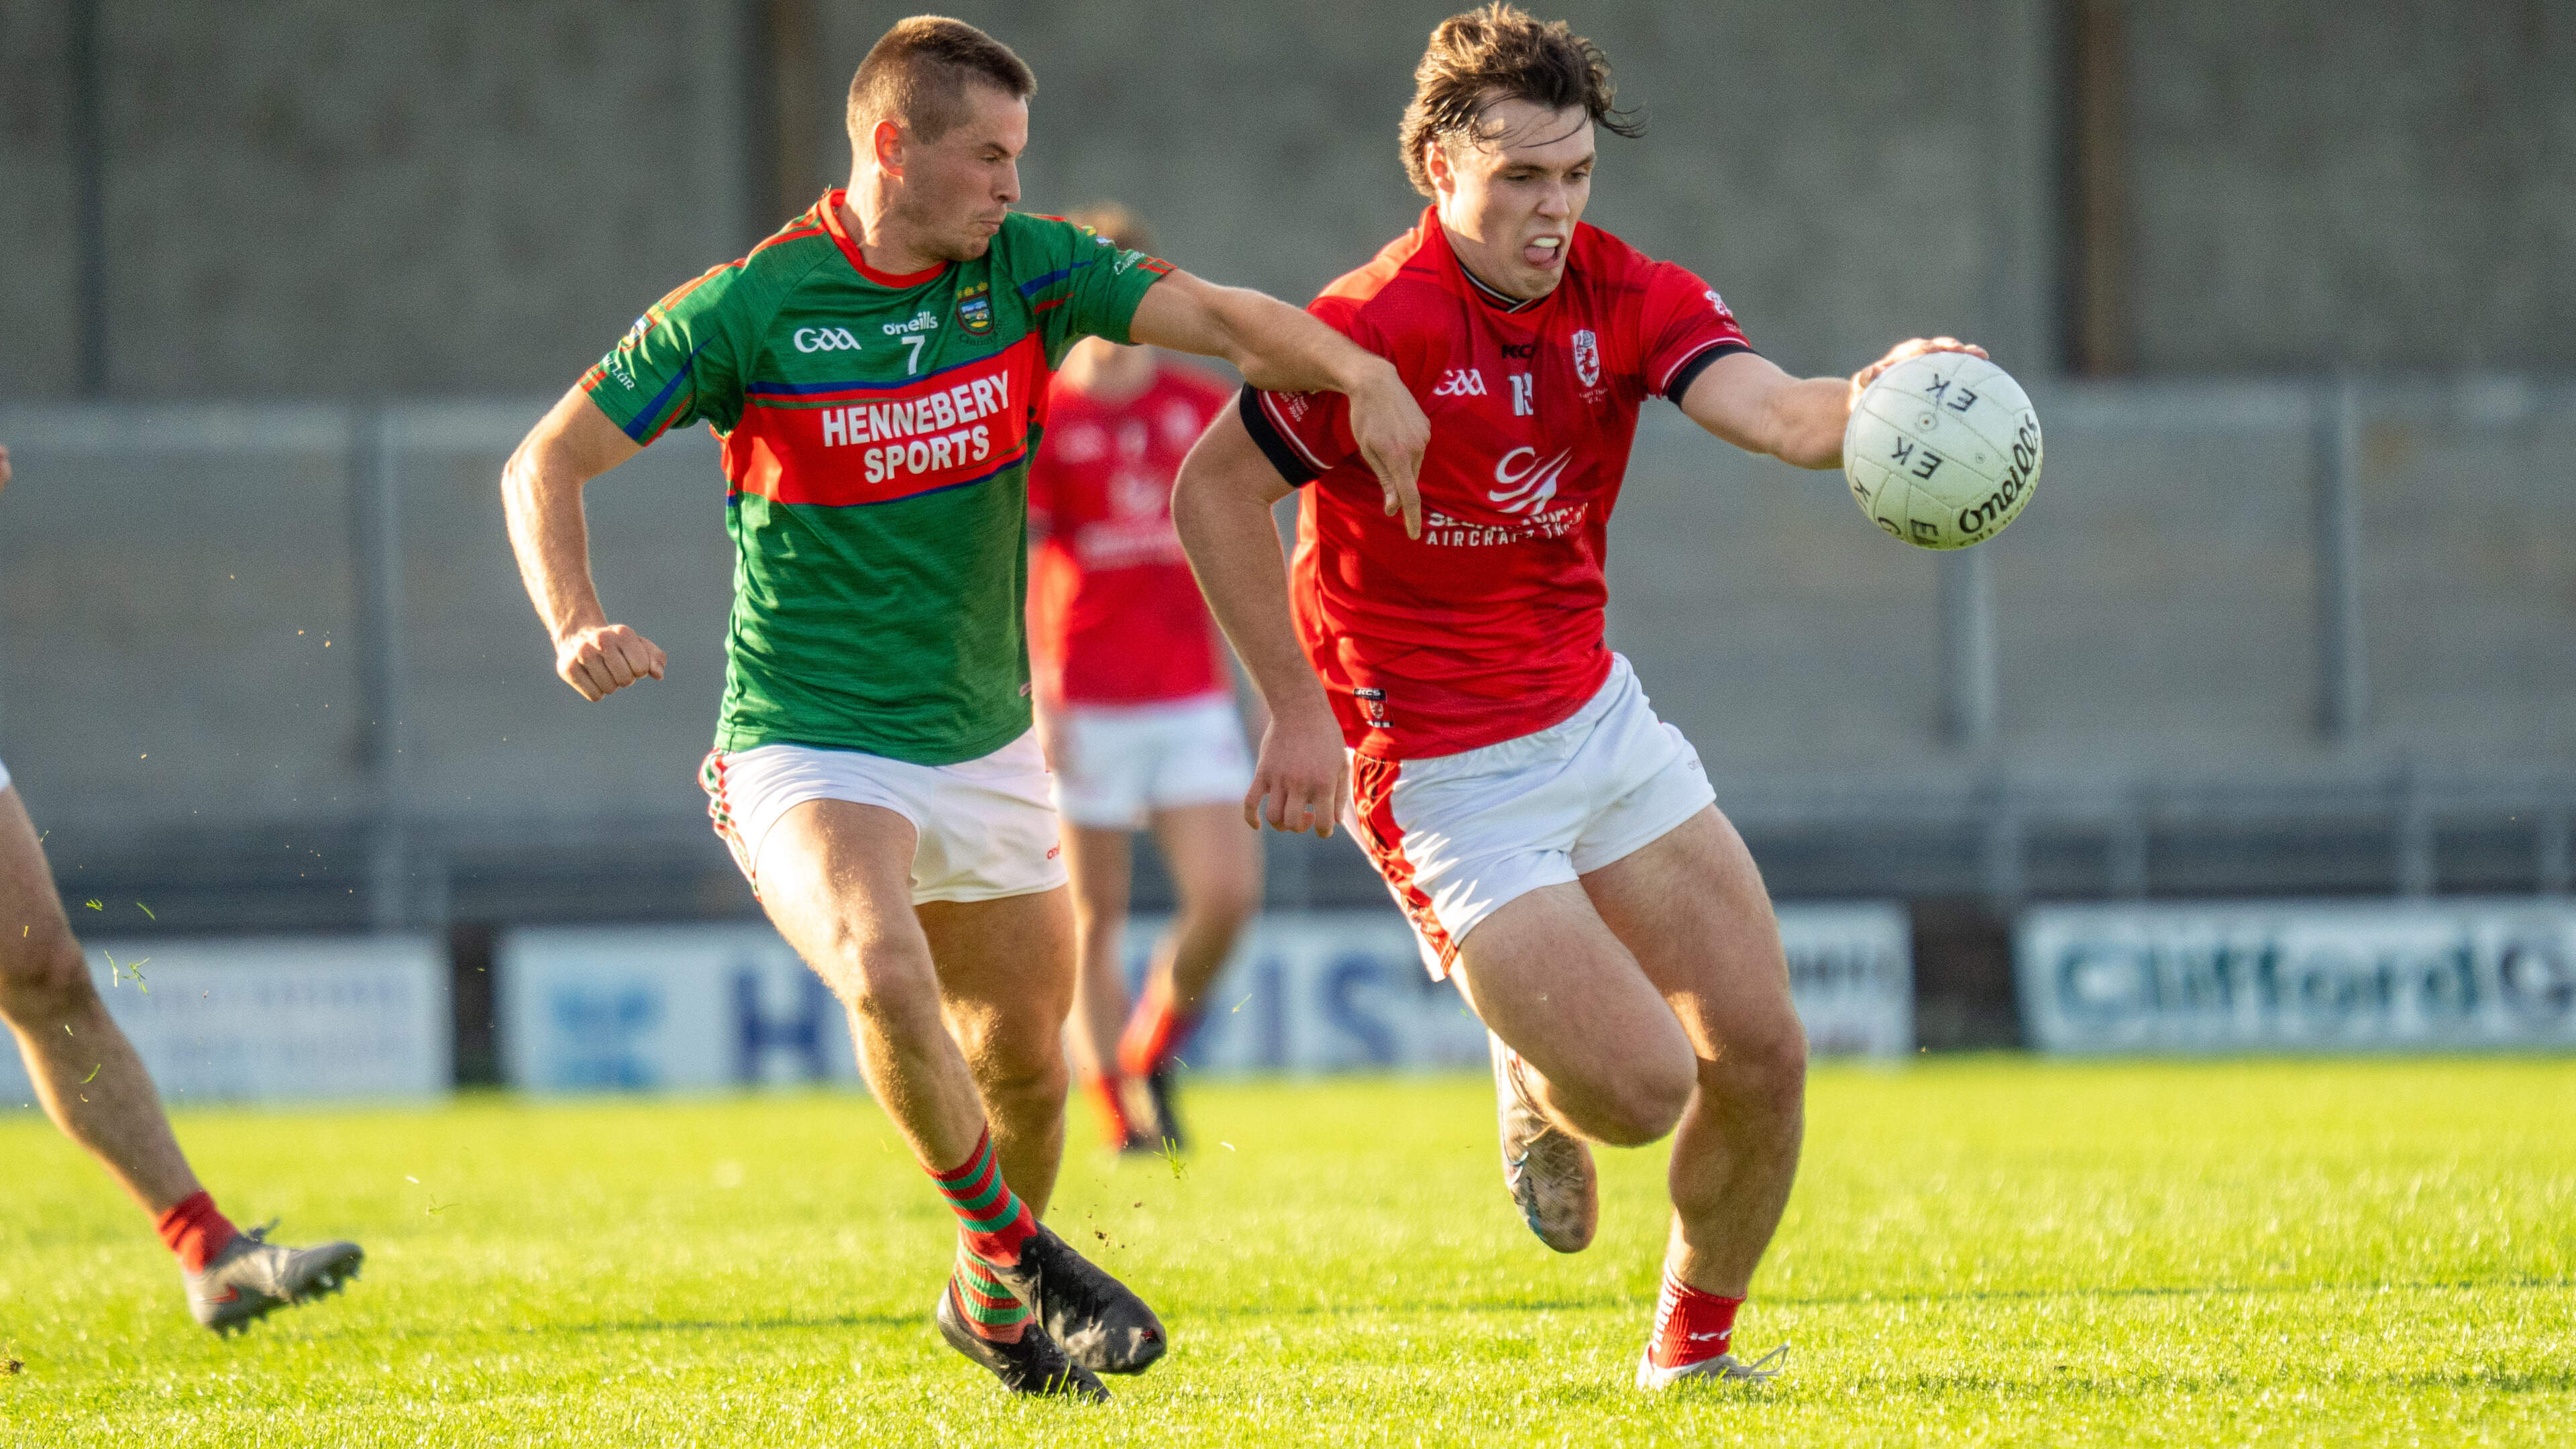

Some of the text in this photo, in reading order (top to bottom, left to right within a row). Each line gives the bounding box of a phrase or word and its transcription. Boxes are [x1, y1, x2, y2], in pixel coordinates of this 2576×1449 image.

[794, 327, 862, 353] GAA
[902, 335, 925, 376] 7
[822, 370, 1009, 447] HENNEBERY
[864, 425, 989, 484] SPORTS
